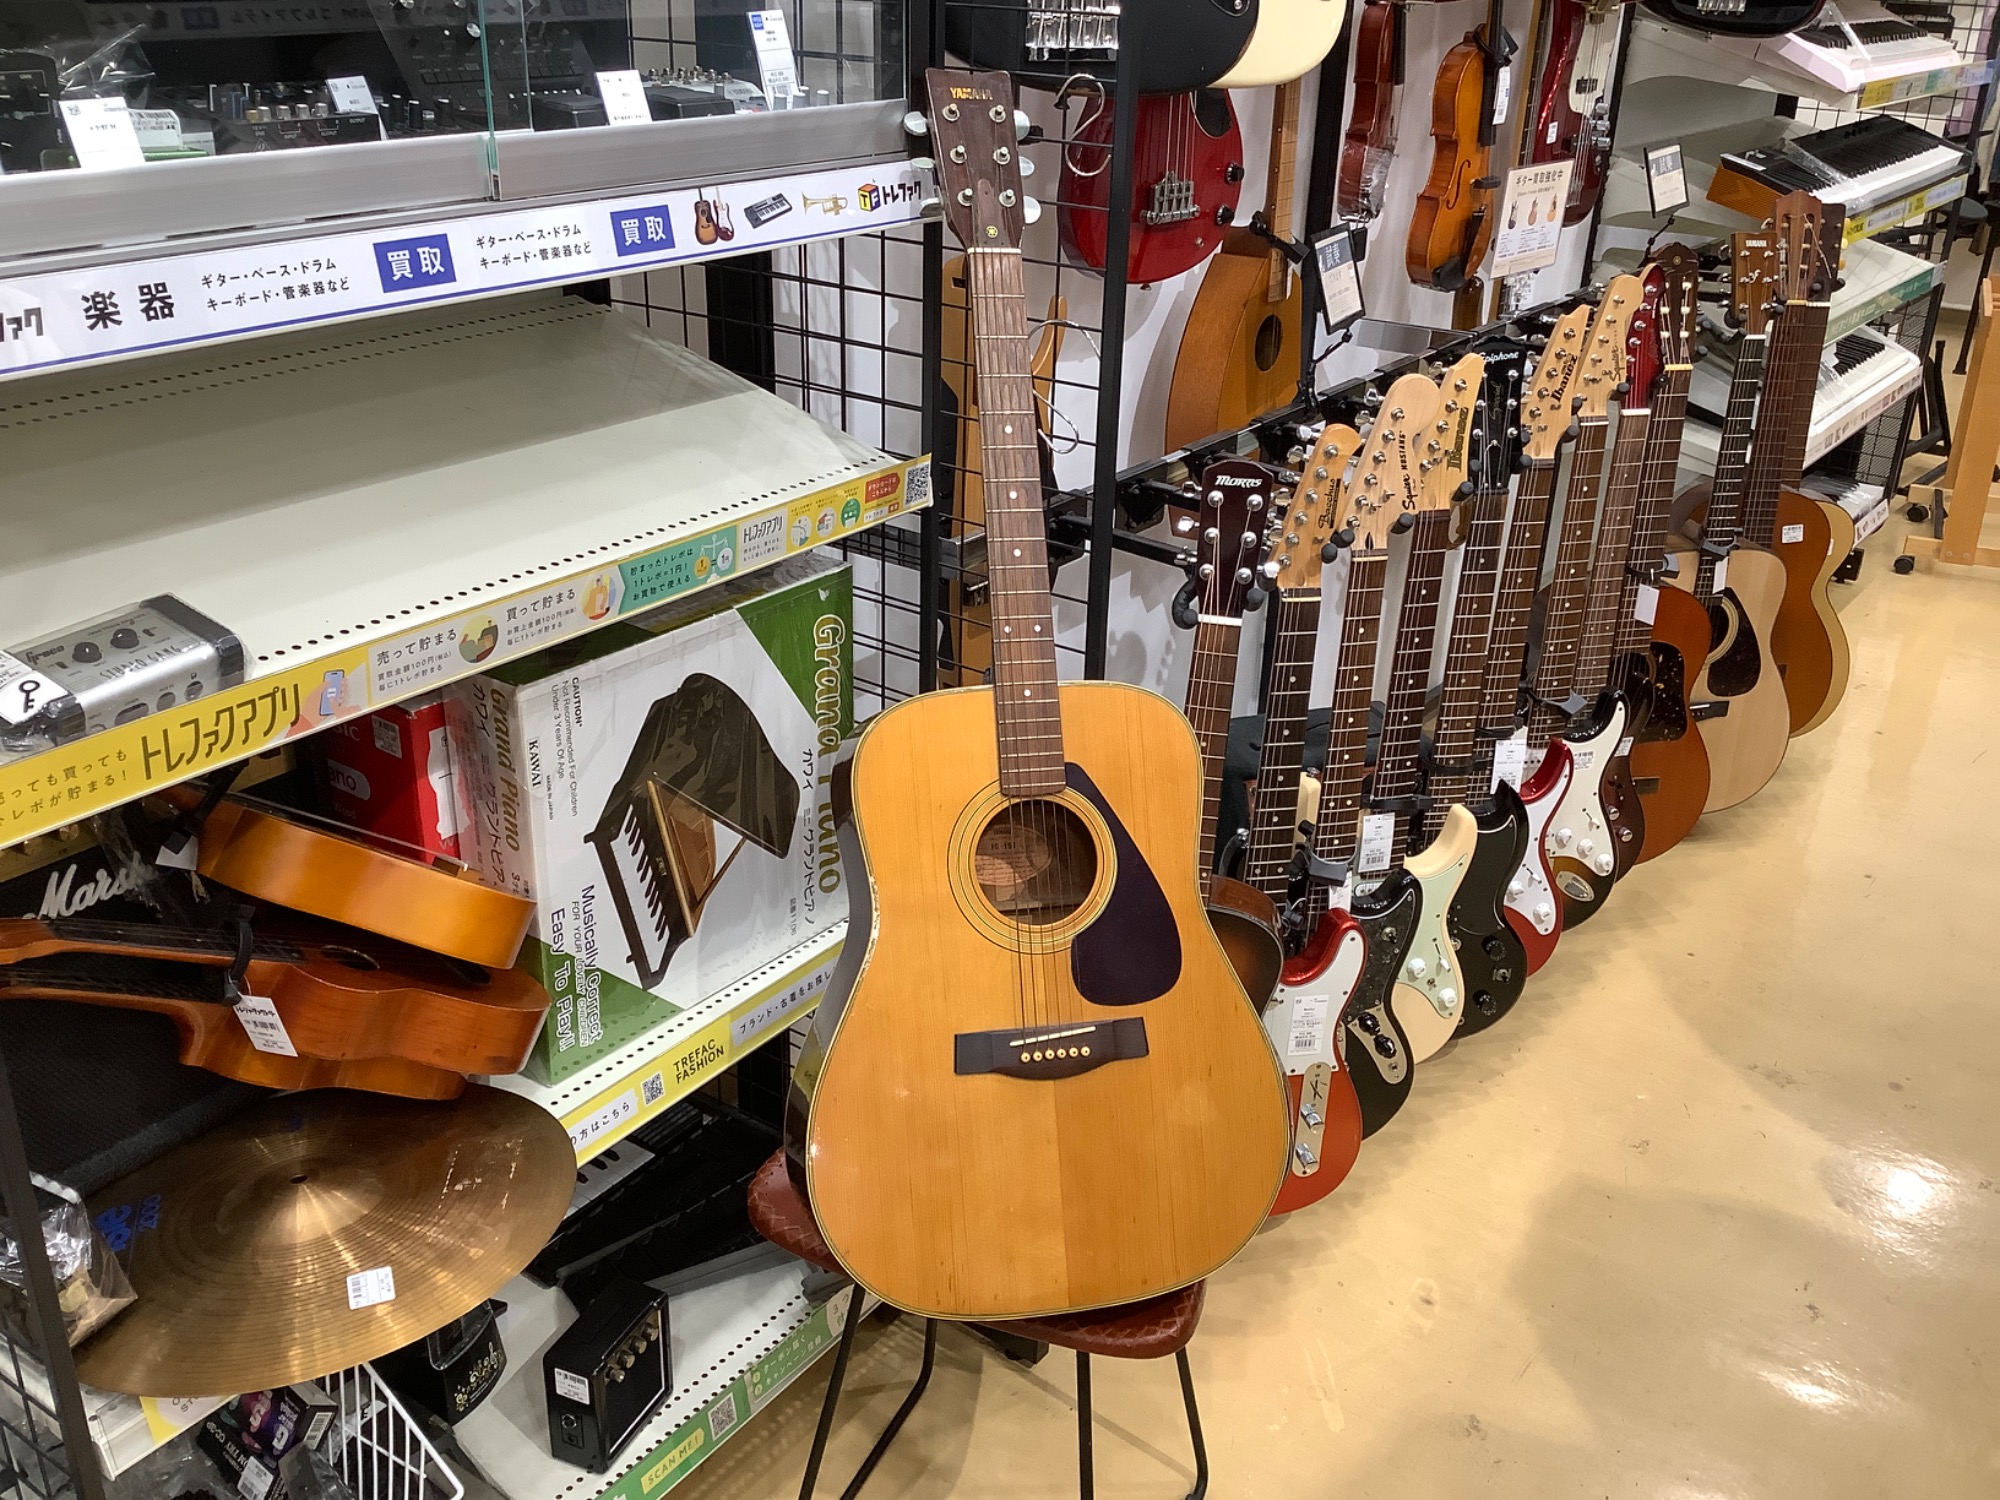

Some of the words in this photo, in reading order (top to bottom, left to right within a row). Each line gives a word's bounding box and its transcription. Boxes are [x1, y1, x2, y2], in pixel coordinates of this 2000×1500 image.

[950, 87, 993, 100] YAMAHA
[882, 180, 922, 205] トレファク
[476, 224, 582, 249] ギター・ベース・ドラム
[621, 215, 667, 247] 買取
[201, 257, 337, 289] ギター・ベース・ドラム
[387, 246, 446, 282] 買取
[480, 241, 592, 269] キーボード・管楽器など
[83, 281, 176, 331] 楽器
[206, 276, 350, 311] キーボード・管楽器など
[1550, 354, 1578, 402] Ibanez
[1446, 406, 1469, 473] Ibanez
[1318, 478, 1336, 529] Bacchus
[743, 515, 783, 543] トレファクアプリ
[506, 587, 576, 622] 買って貯まる
[376, 628, 457, 667] 売って貯まる
[472, 682, 491, 738] カワイ
[141, 683, 301, 780] トレファクアプリ
[528, 739, 542, 788] KAWAI
[803, 749, 814, 791] カワイ
[500, 775, 521, 852] Piano
[571, 901, 580, 921] FOR
[581, 885, 598, 968] Musically
[551, 908, 566, 955] Easy
[573, 926, 582, 954] YOUR
[555, 963, 570, 990] To
[586, 973, 602, 1043] Correct
[739, 971, 832, 1034] ブランド・古着をお探し
[557, 995, 575, 1051] Play!!
[673, 1039, 716, 1073] TREFAC
[675, 1046, 724, 1084] FASHION
[648, 1455, 676, 1485] SCAN
